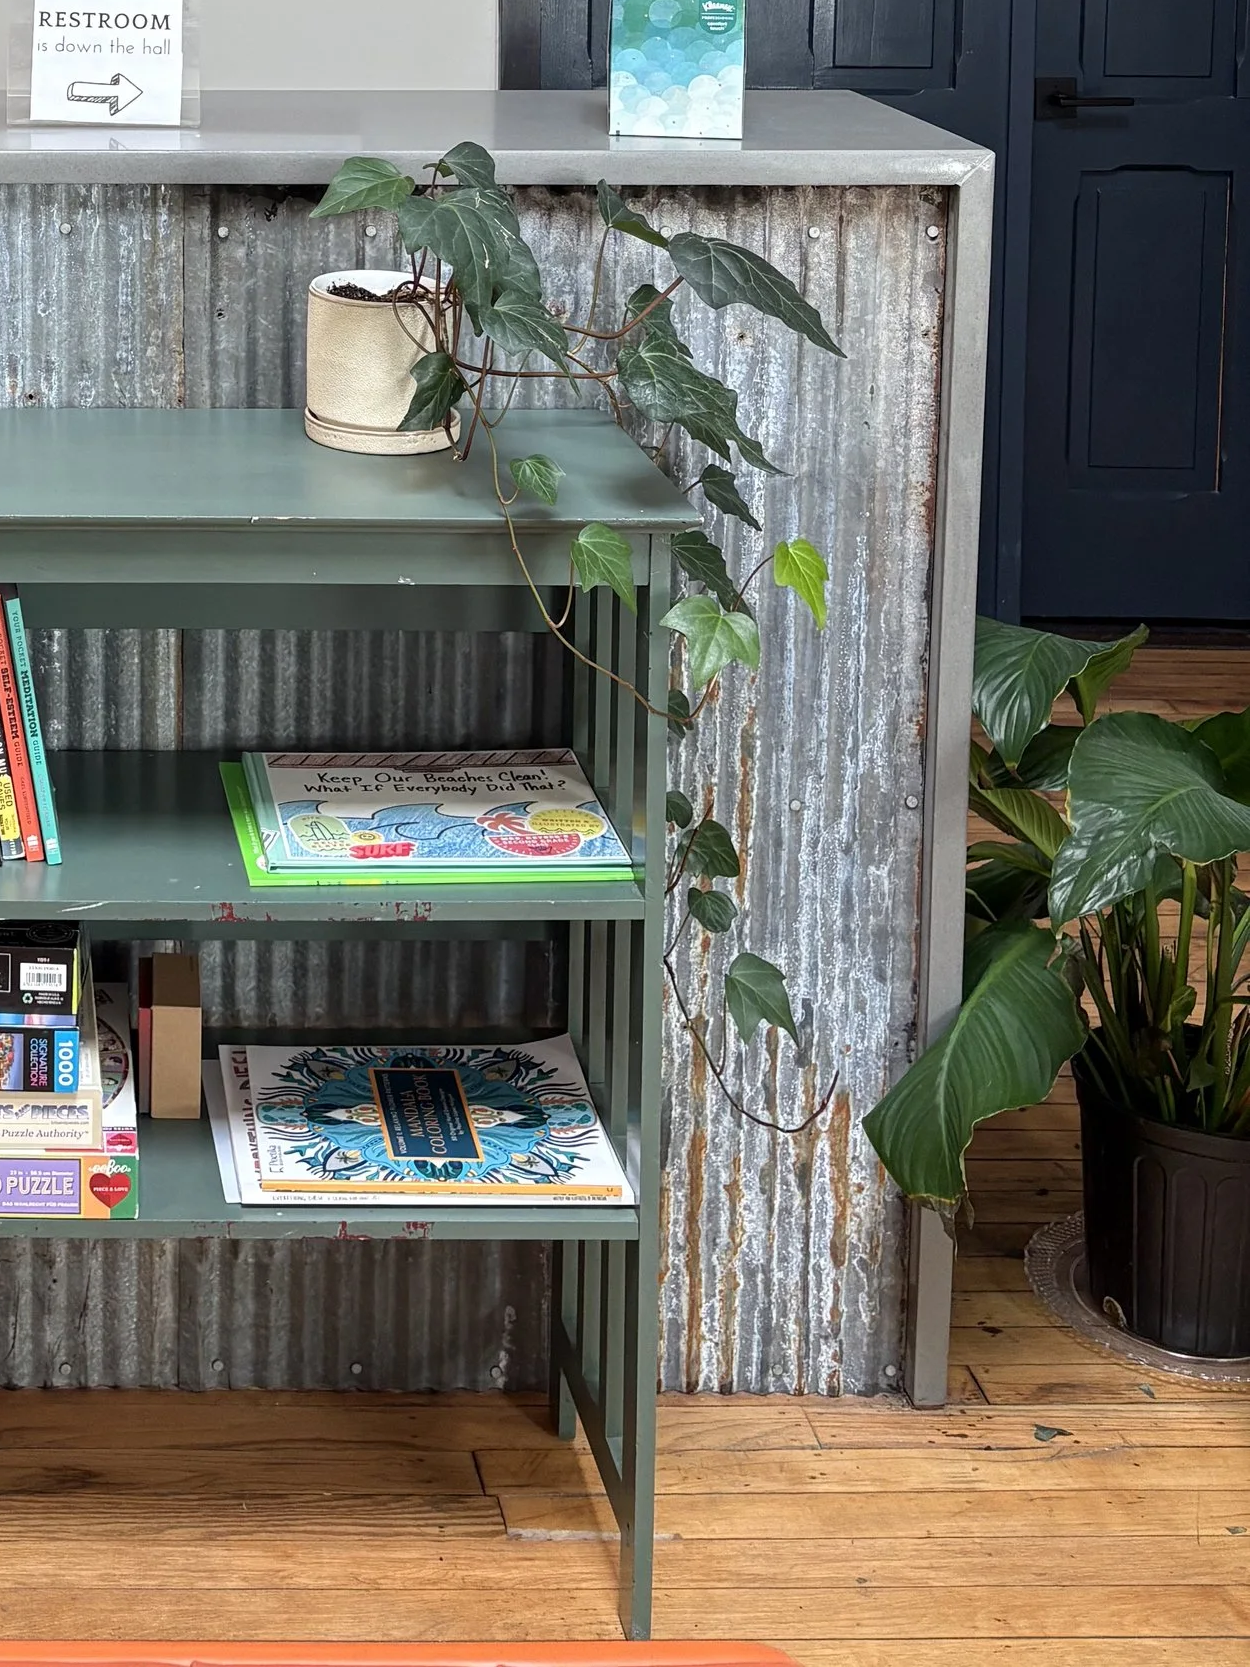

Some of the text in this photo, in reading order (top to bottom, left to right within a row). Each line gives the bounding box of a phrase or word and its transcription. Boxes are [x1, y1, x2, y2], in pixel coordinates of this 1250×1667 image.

[38, 11, 171, 30] RESTROOM
[37, 36, 171, 55] is down the hall
[12, 610, 42, 765] YOUR POCKET MEDITATION GUIDE
[1, 667, 20, 740] SELF-ESTEEM
[14, 743, 23, 766] GUIDE
[317, 769, 548, 785] Keep Our Beaches Clean!
[3, 782, 13, 807] USED
[394, 784, 477, 796] Everybody
[486, 783, 515, 792] Did
[349, 842, 414, 859] SURF
[30, 1038, 38, 1086] COLLECTION
[39, 1039, 48, 1086] SIGNATURE
[58, 1040, 74, 1086] 1000
[31, 1105, 88, 1120] PIECES
[399, 1090, 424, 1138] MANDALA
[413, 1074, 447, 1154] COLORING BOOK
[1, 1129, 34, 1138] Puzzle
[7, 1176, 74, 1195] PUZZLE
